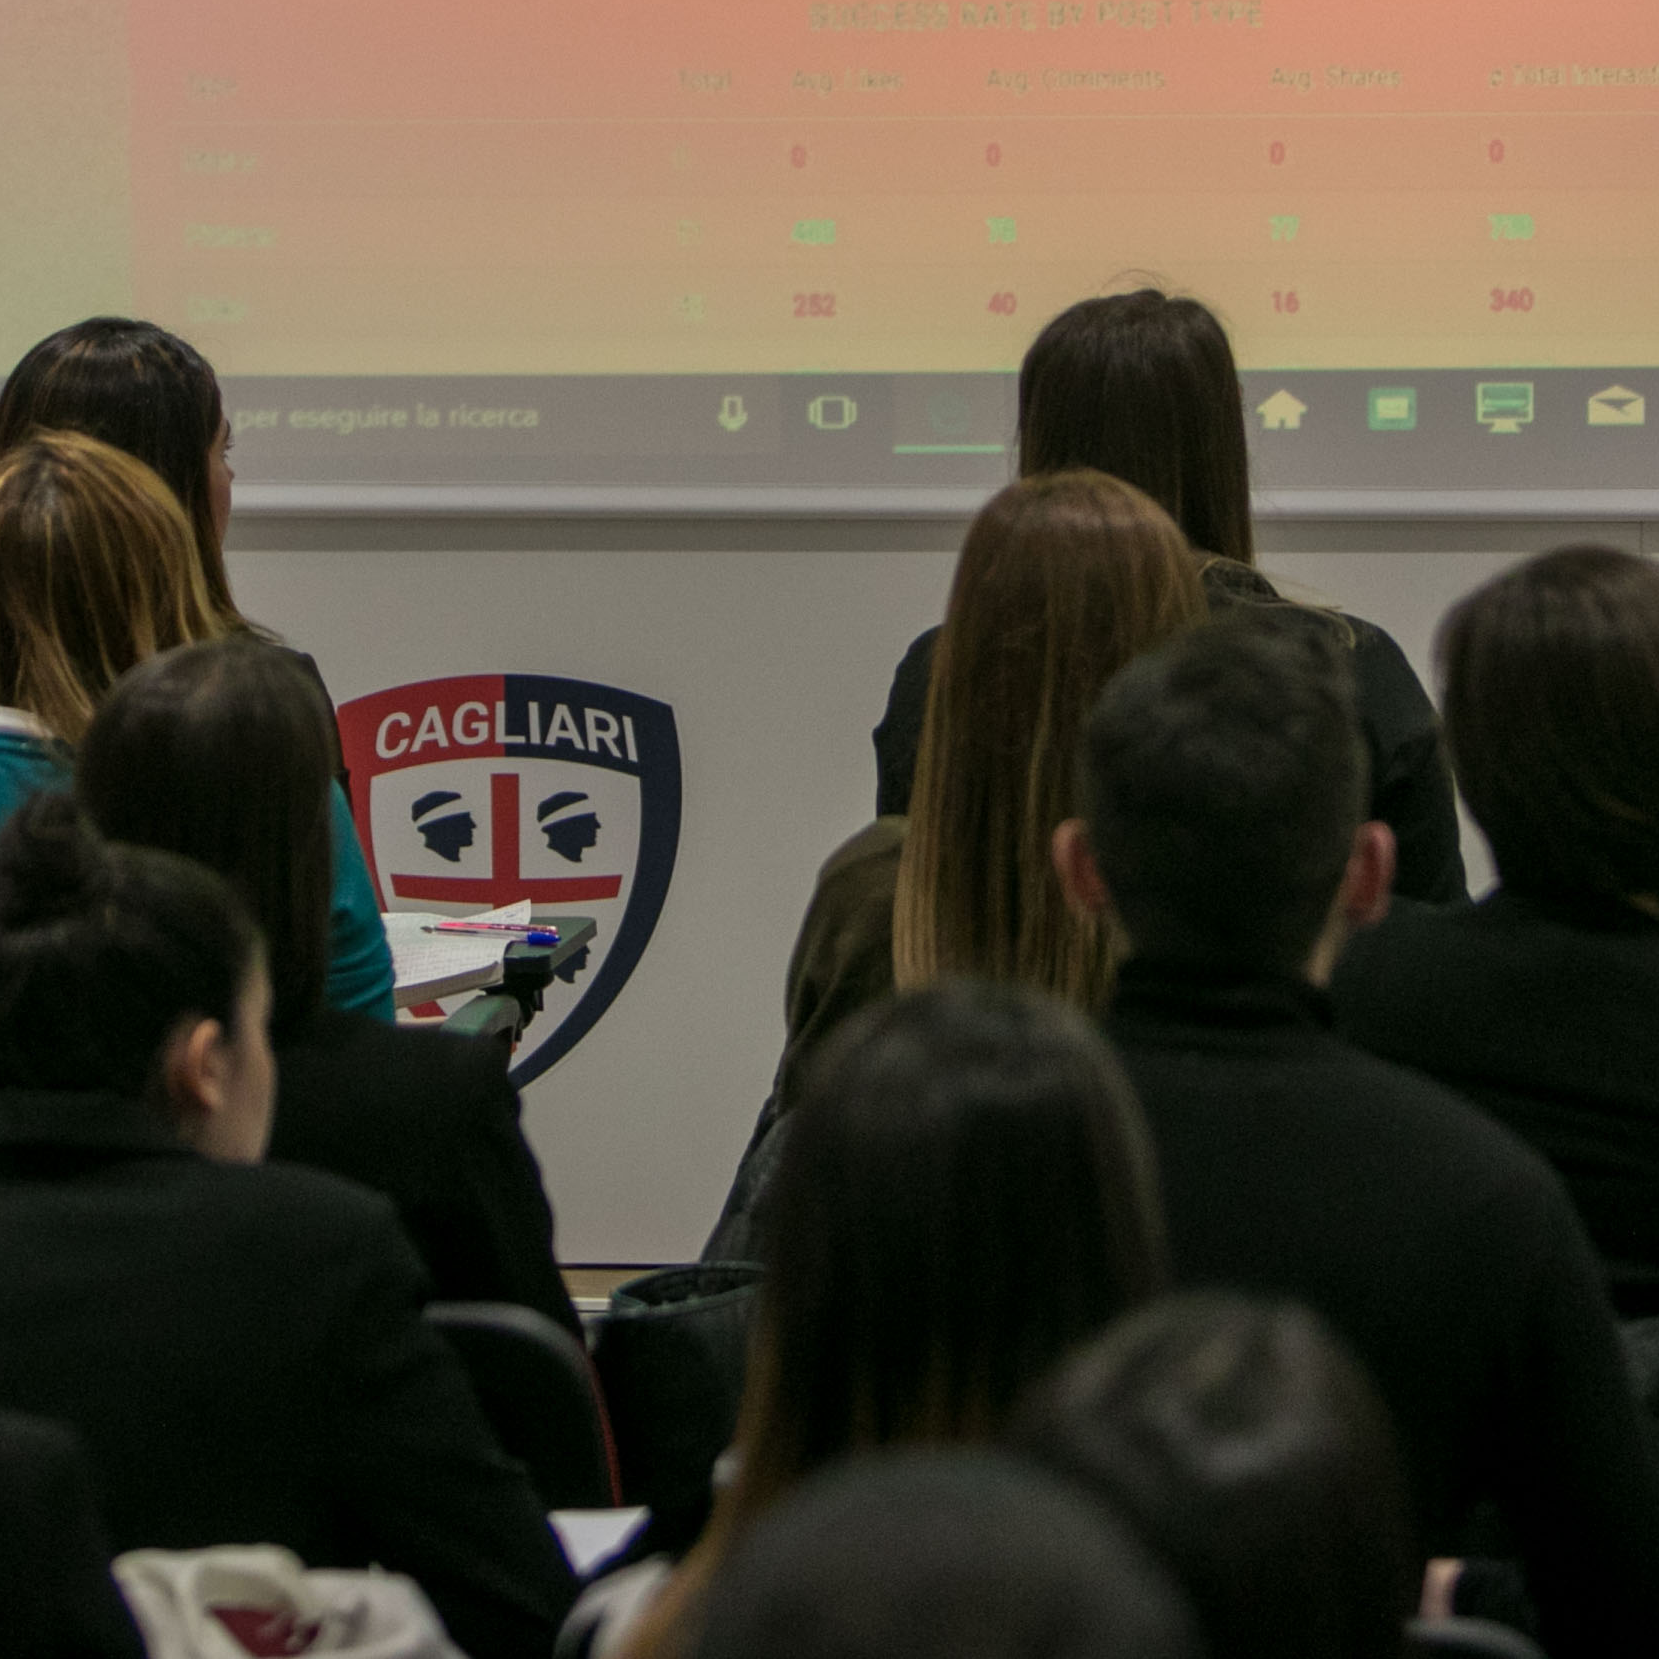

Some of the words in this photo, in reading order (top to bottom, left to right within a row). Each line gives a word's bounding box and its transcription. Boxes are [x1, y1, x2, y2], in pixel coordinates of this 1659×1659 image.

[960, 1, 1037, 31] RATE
[1046, 1, 1085, 31] BY
[1097, 0, 1173, 30] POST
[1042, 68, 1167, 91] Comments
[791, 144, 808, 170] 0
[985, 142, 1002, 168] 0
[1268, 141, 1286, 166] 0
[1488, 139, 1505, 164] 0
[792, 292, 837, 319] 252
[987, 291, 1018, 318] 40
[1271, 290, 1301, 315] 16
[1488, 287, 1535, 313] 340
[235, 407, 280, 433] per
[288, 404, 409, 435] eseguire
[416, 403, 441, 430] la
[448, 403, 540, 429] ricerca
[374, 700, 640, 764] CAGLIARI
